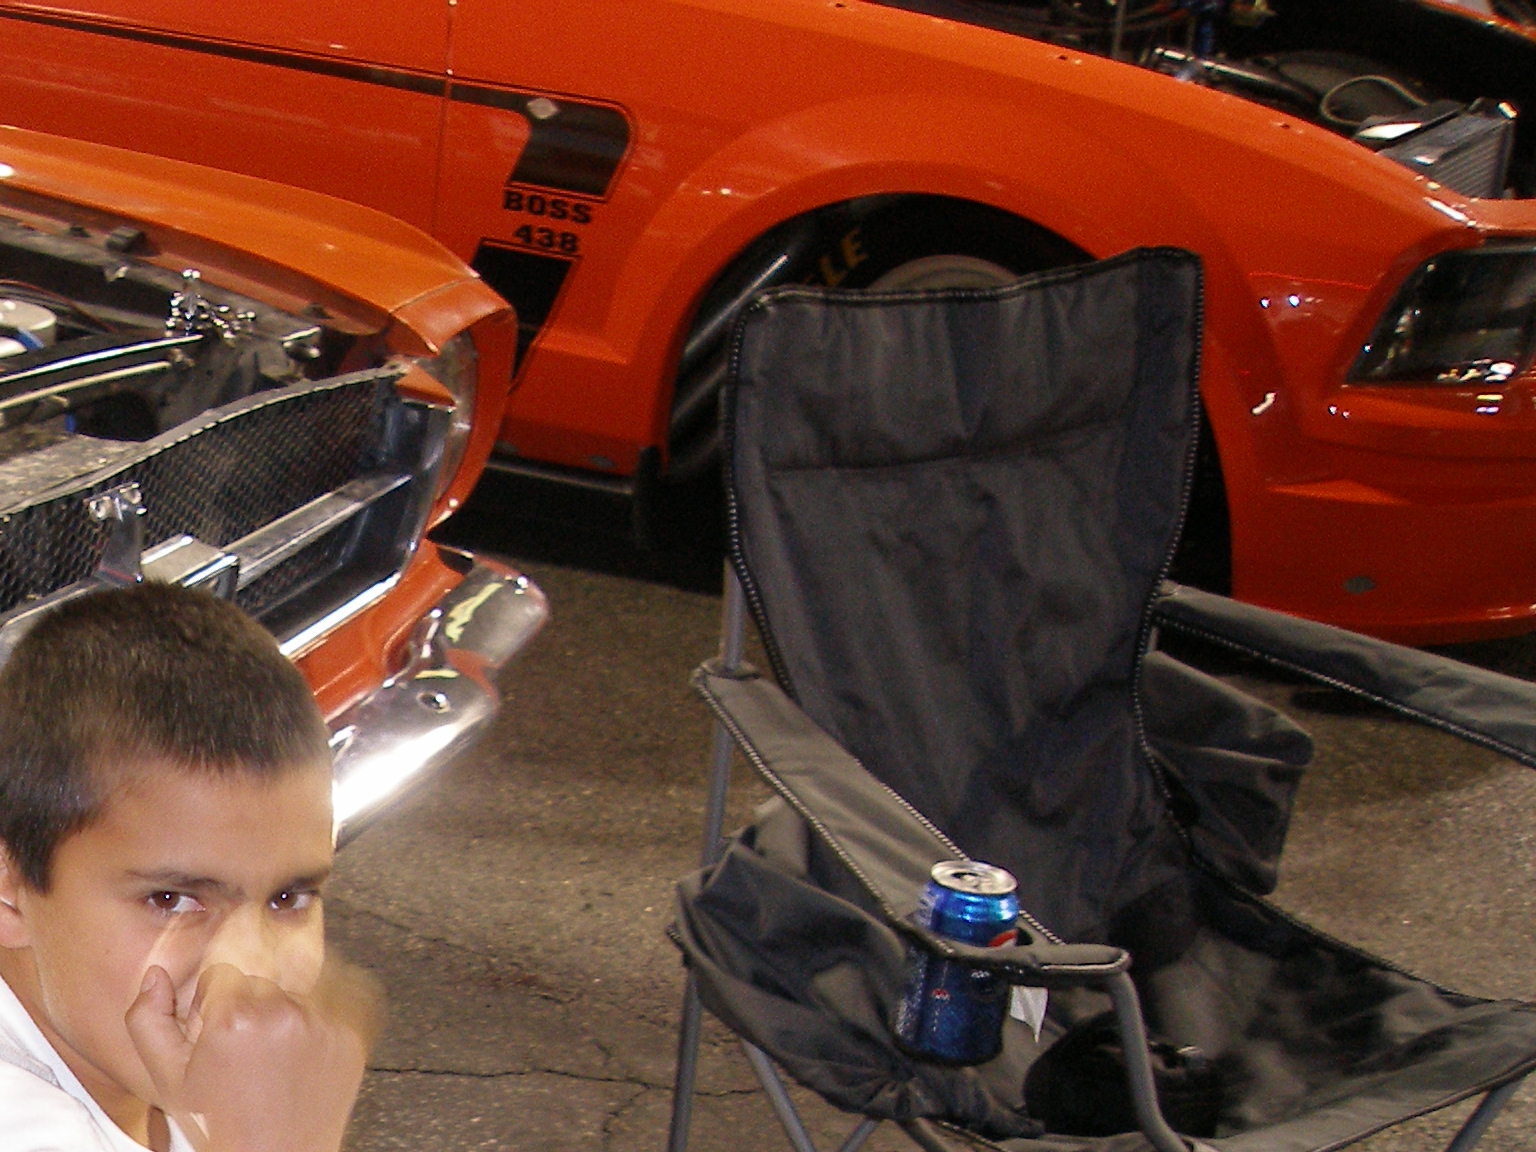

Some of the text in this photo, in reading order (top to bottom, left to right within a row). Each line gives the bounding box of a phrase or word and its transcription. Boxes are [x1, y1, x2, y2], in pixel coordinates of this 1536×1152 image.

[503, 190, 592, 224] BOSS
[514, 224, 578, 254] 438
[805, 226, 868, 287] LE
